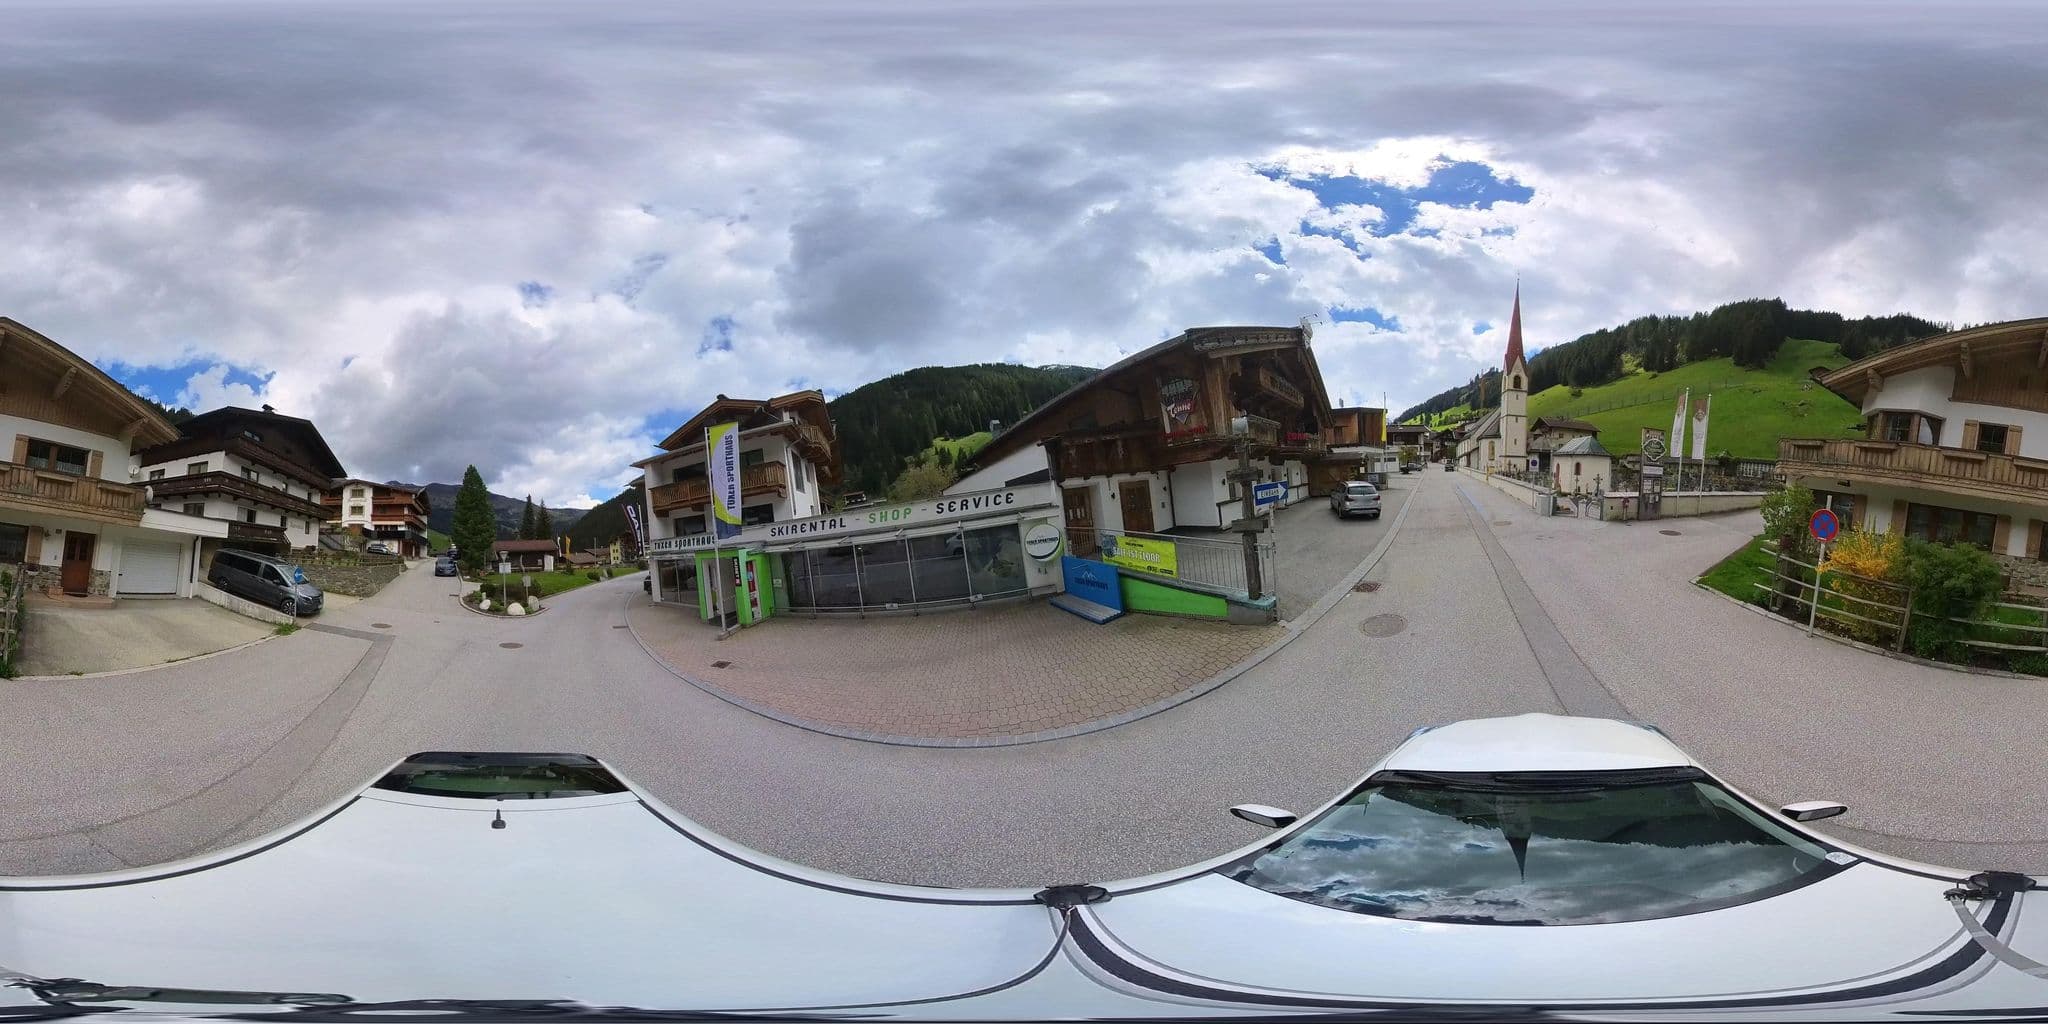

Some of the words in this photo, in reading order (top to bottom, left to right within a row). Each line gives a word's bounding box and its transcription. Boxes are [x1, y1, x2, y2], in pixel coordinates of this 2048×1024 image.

[724, 434, 735, 483] SPORTHAUS
[726, 484, 736, 511] TUXER
[770, 516, 847, 537] SKIRENTAL
[868, 507, 913, 524] SHOP
[936, 492, 1015, 515] SERVICE
